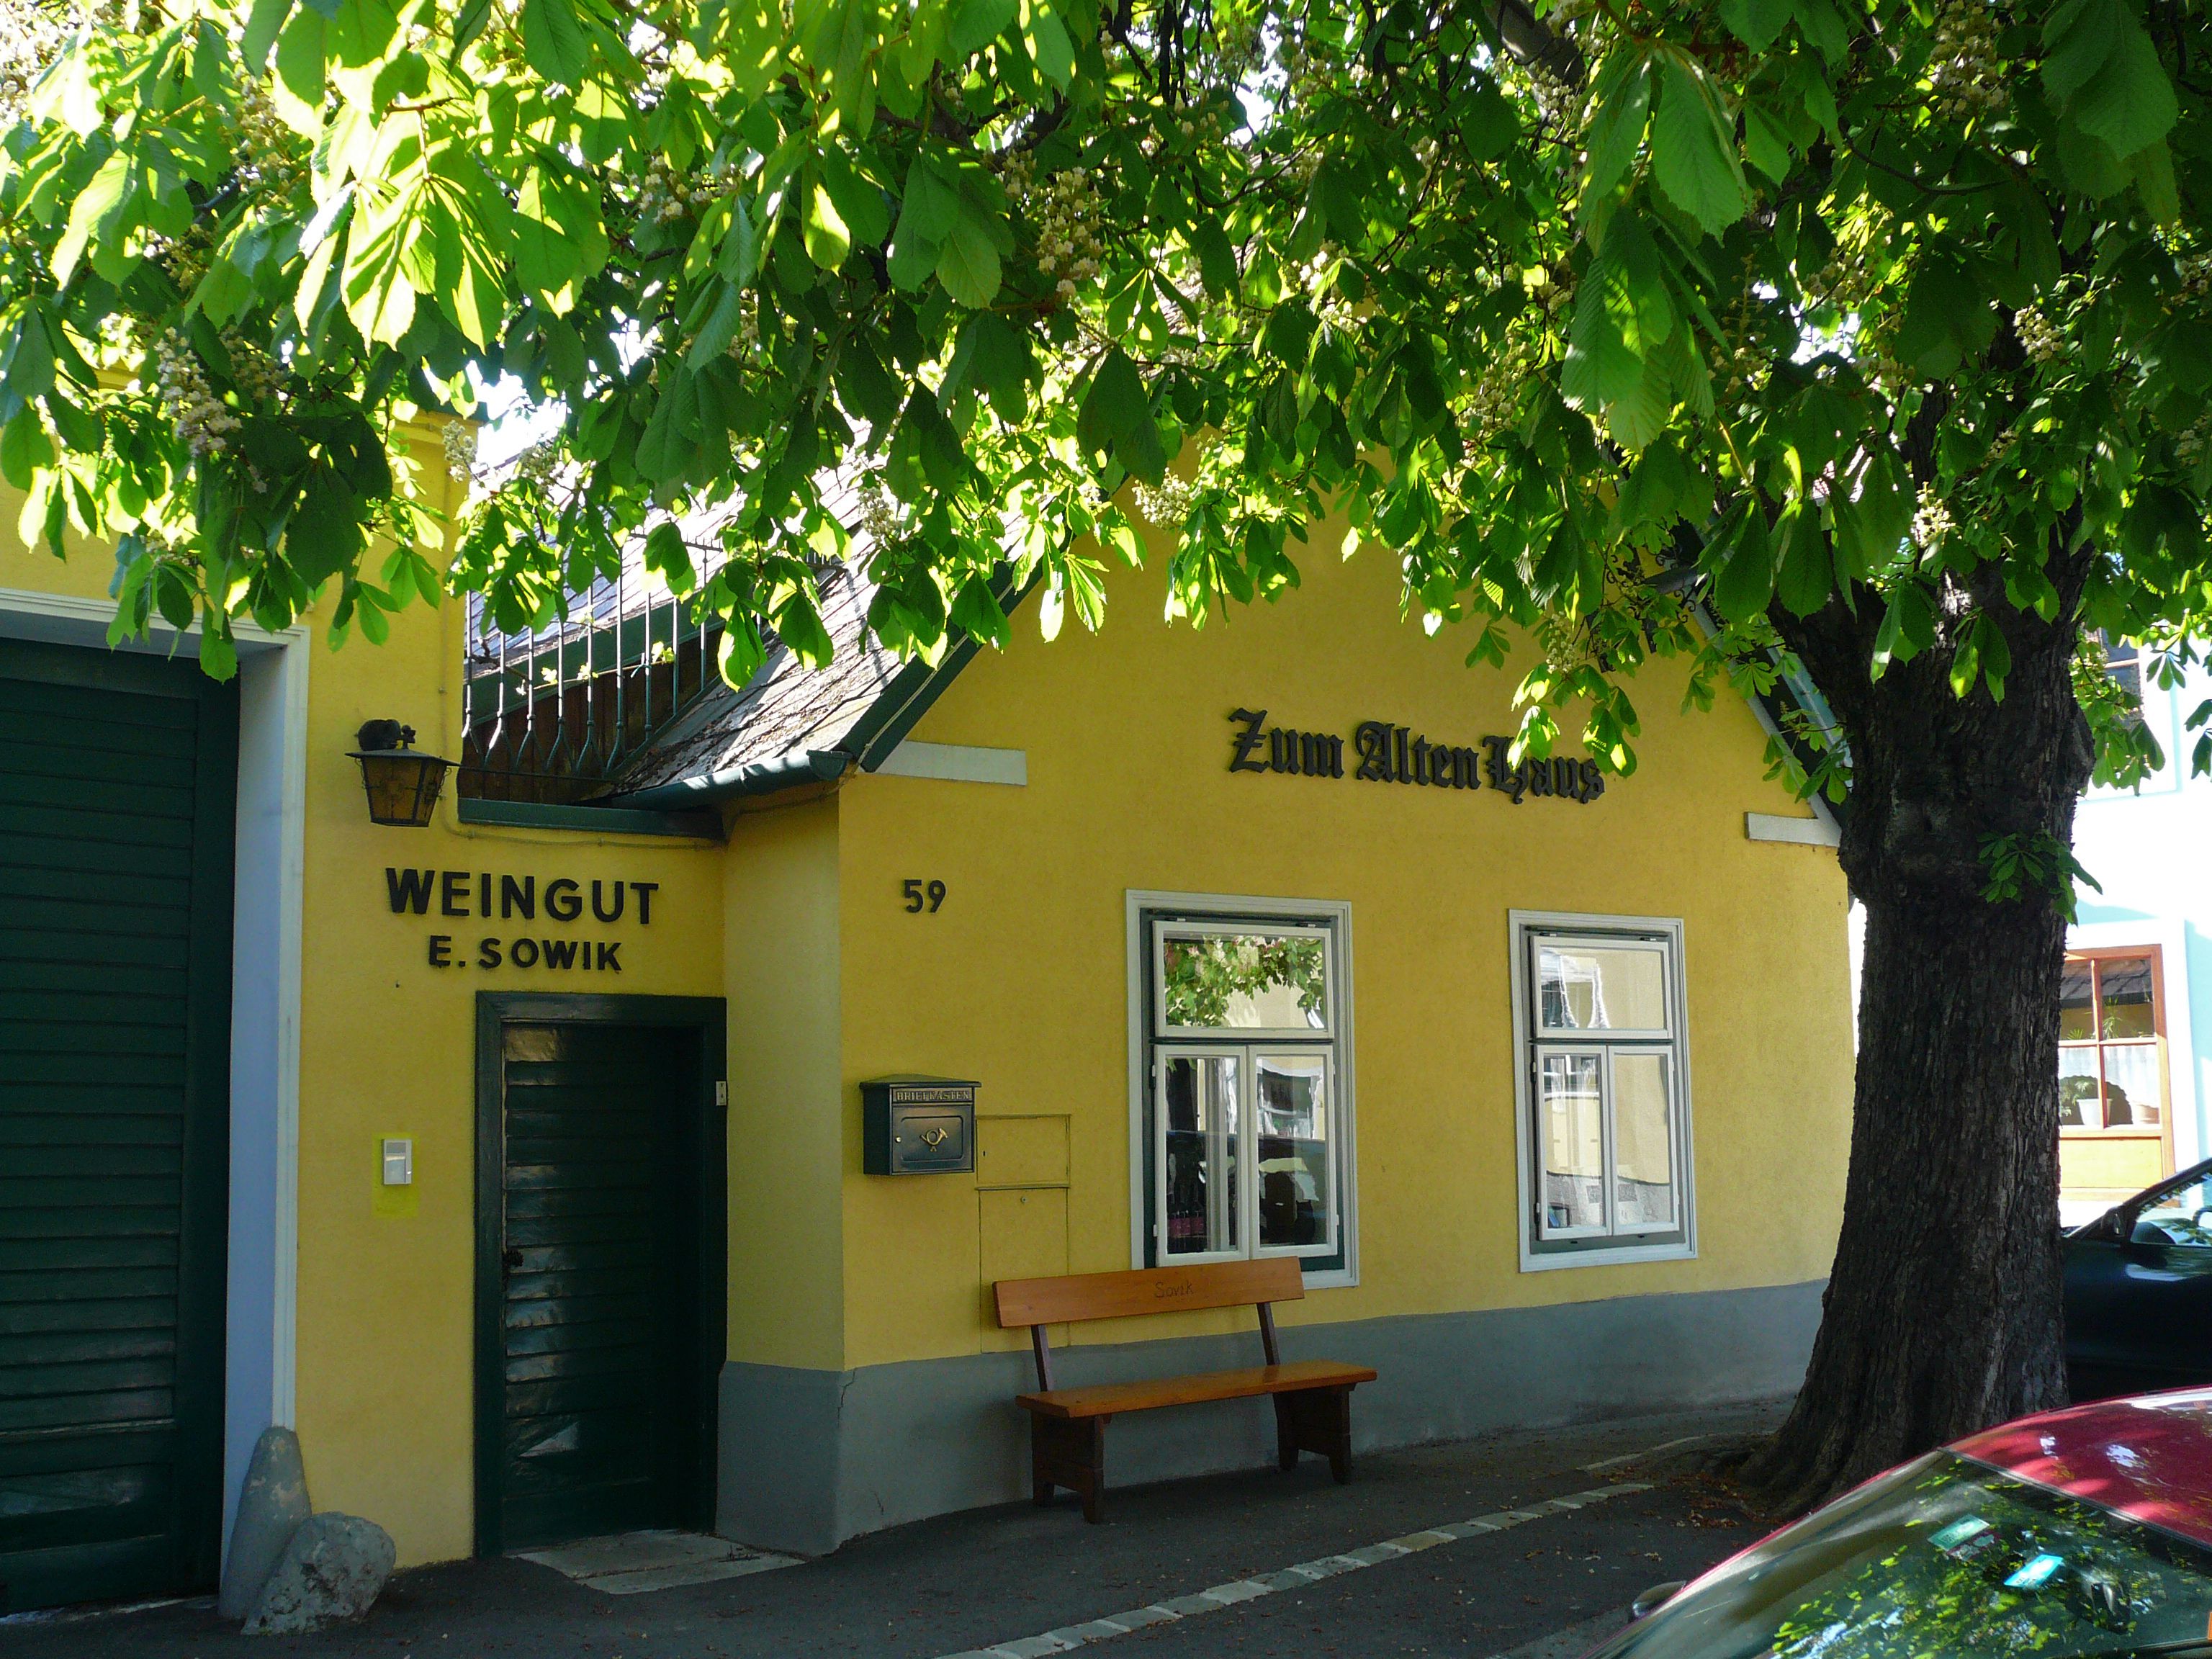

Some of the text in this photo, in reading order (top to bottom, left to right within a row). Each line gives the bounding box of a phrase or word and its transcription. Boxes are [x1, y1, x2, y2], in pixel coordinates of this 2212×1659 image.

[1228, 708, 1604, 804] Zum Alten Haus
[385, 867, 659, 925] WEINGUT
[904, 879, 946, 913] 59
[896, 1090, 970, 1101] BRIEFKASTEN
